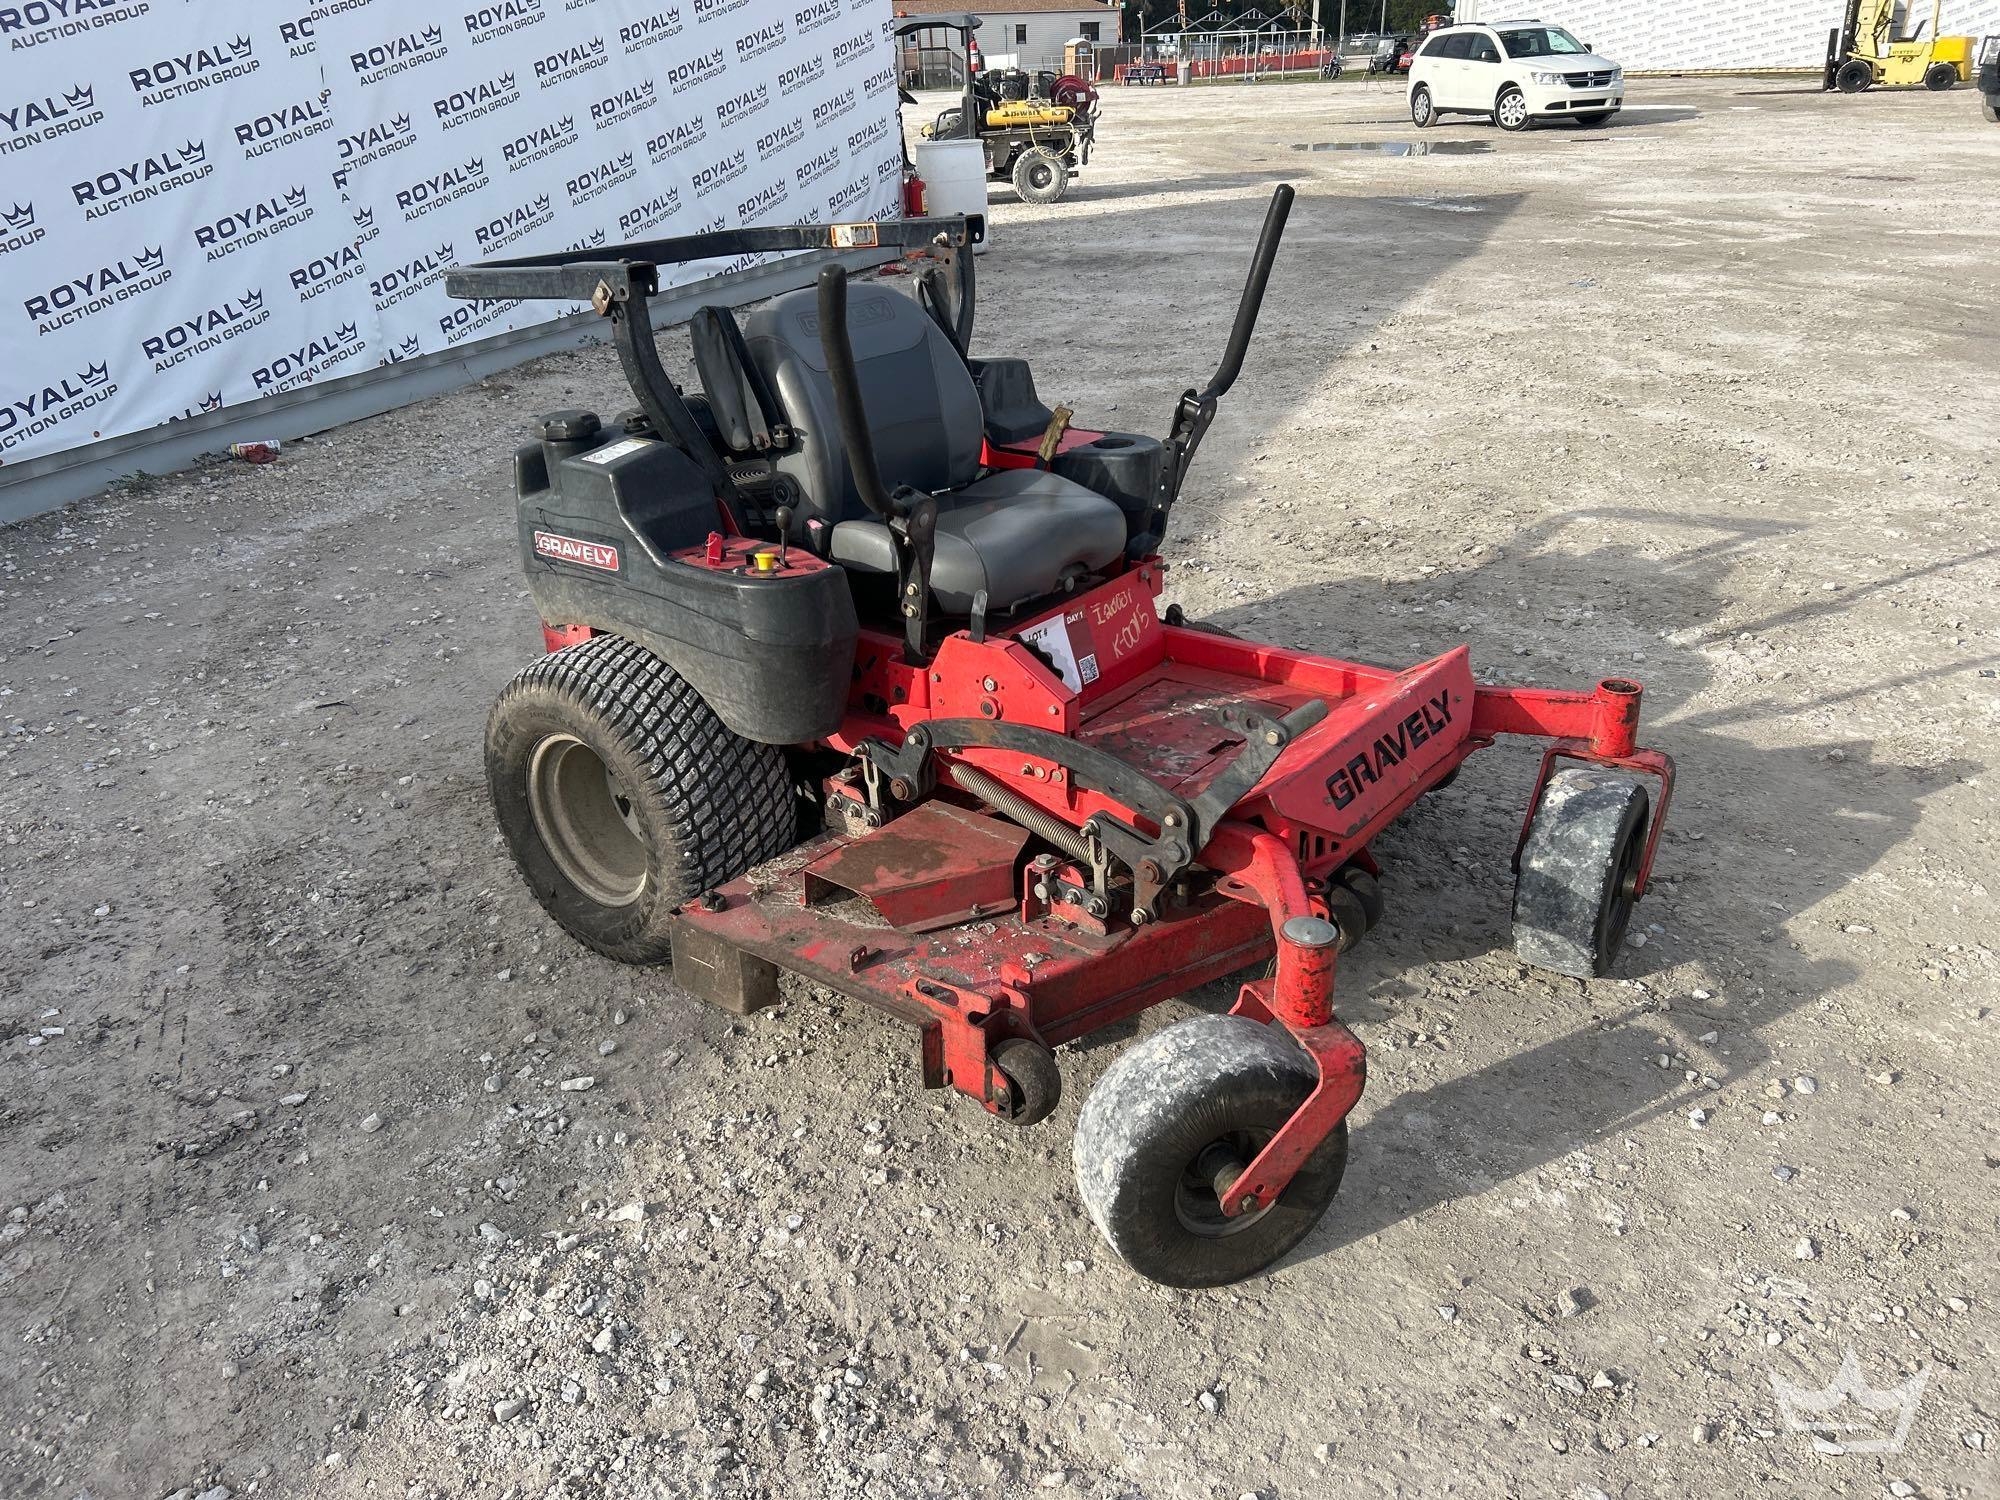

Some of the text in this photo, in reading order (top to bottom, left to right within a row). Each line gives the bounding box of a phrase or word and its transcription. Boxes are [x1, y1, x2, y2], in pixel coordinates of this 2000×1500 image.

[11, 2, 150, 51] AUCTION GROUP
[464, 0, 527, 32] ROYAL
[471, 11, 546, 46] AUCTION GROUP
[619, 13, 669, 44] ROYAL
[698, 7, 728, 25] AUCTION
[795, 1, 831, 26] ROYAL
[798, 11, 841, 35] AUCTION GROUP
[350, 34, 425, 72] ROYAL
[624, 24, 683, 55] AUCTION GROUP
[736, 25, 775, 54] ROYAL
[740, 36, 787, 64] AUCTION GROUP
[832, 35, 866, 60] ROYAL
[835, 44, 875, 68] AUCTION GROUP
[129, 45, 232, 91] ROYAL
[360, 47, 449, 86] AUCTION GROUP
[534, 44, 591, 78] ROYAL
[540, 56, 609, 90] AUCTION GROUP
[668, 55, 713, 85] ROYAL
[778, 60, 814, 88] ROYAL
[142, 59, 260, 107] AUCTION GROUP
[672, 64, 727, 95] AUCTION GROUP
[781, 70, 825, 97] AUCTION GROUP
[863, 67, 894, 92] ROYAL
[867, 85, 887, 100] AUCTION
[0, 97, 68, 132] YAL
[433, 80, 501, 118] ROYAL
[442, 92, 520, 131] AUCTION GROUP
[590, 87, 643, 120] ROYAL
[595, 97, 658, 131] AUCTION GROUP
[716, 90, 758, 120] ROYAL
[720, 98, 770, 130] AUCTION GROUP
[812, 94, 846, 121] ROYAL
[816, 102, 857, 129] AUCTION GROUP
[0, 110, 104, 154] TION GROUP
[234, 99, 322, 146] ROYAL
[245, 117, 335, 161] AUCTION GRO
[646, 123, 693, 155] ROYAL
[757, 123, 795, 152] ROYAL
[847, 122, 880, 149] ROYAL
[337, 122, 395, 158] OYAL
[343, 134, 417, 172] CTION GROUP
[502, 124, 561, 161] ROYAL
[509, 134, 579, 174] AUCTION GROUP
[651, 131, 707, 166] AUCTION GROUP
[760, 131, 805, 162] AUCTION GROUP
[851, 131, 889, 157] AUCTION GROUP
[71, 153, 182, 205] ROYAL
[566, 160, 620, 196] ROYAL
[692, 157, 735, 189] ROYAL
[696, 165, 748, 199] AUCTION GROUP
[796, 153, 830, 181] ROYAL
[800, 159, 841, 190] AUCTION GROUP
[85, 164, 214, 221] AUCTION GROUP
[396, 168, 468, 210] ROYAL
[404, 177, 490, 222] AUCTION GROUP
[572, 168, 637, 207] AUCTION GROUP
[738, 187, 775, 217] ROYAL
[828, 180, 861, 209] ROYAL
[831, 187, 871, 217] AUCTION GROUP
[194, 198, 287, 249] ROYAL
[475, 204, 536, 244] ROYAL
[619, 198, 669, 231] ROYAL
[624, 202, 682, 241] AUCTION GROUP
[741, 193, 788, 226] AUCTION GROUP
[866, 205, 893, 222] OYAL
[0, 228, 46, 255] ROUP
[207, 207, 314, 263] AUCTION GROUP
[482, 211, 554, 256] AUCTION GROUP
[24, 261, 139, 320] ROYAL
[300, 271, 353, 302] AUCTION
[370, 255, 438, 297] ROYAL
[39, 269, 172, 336] AUCTION GROUP
[375, 282, 422, 312] AUCTION
[142, 303, 244, 360] ROYAL
[440, 298, 503, 334] ROYA
[447, 315, 491, 345] AUCTION
[155, 310, 270, 374] AUCTION GROUP
[252, 335, 339, 389] ROYAL
[262, 365, 321, 398] AUCTION
[322, 341, 366, 370] GROUP
[0, 379, 84, 433] OYAL
[0, 414, 58, 451] CTION
[60, 384, 118, 420] GROUP
[538, 535, 614, 566] GRAVELY
[1066, 613, 1080, 625] DAY
[1325, 688, 1453, 812] GRAVELY
